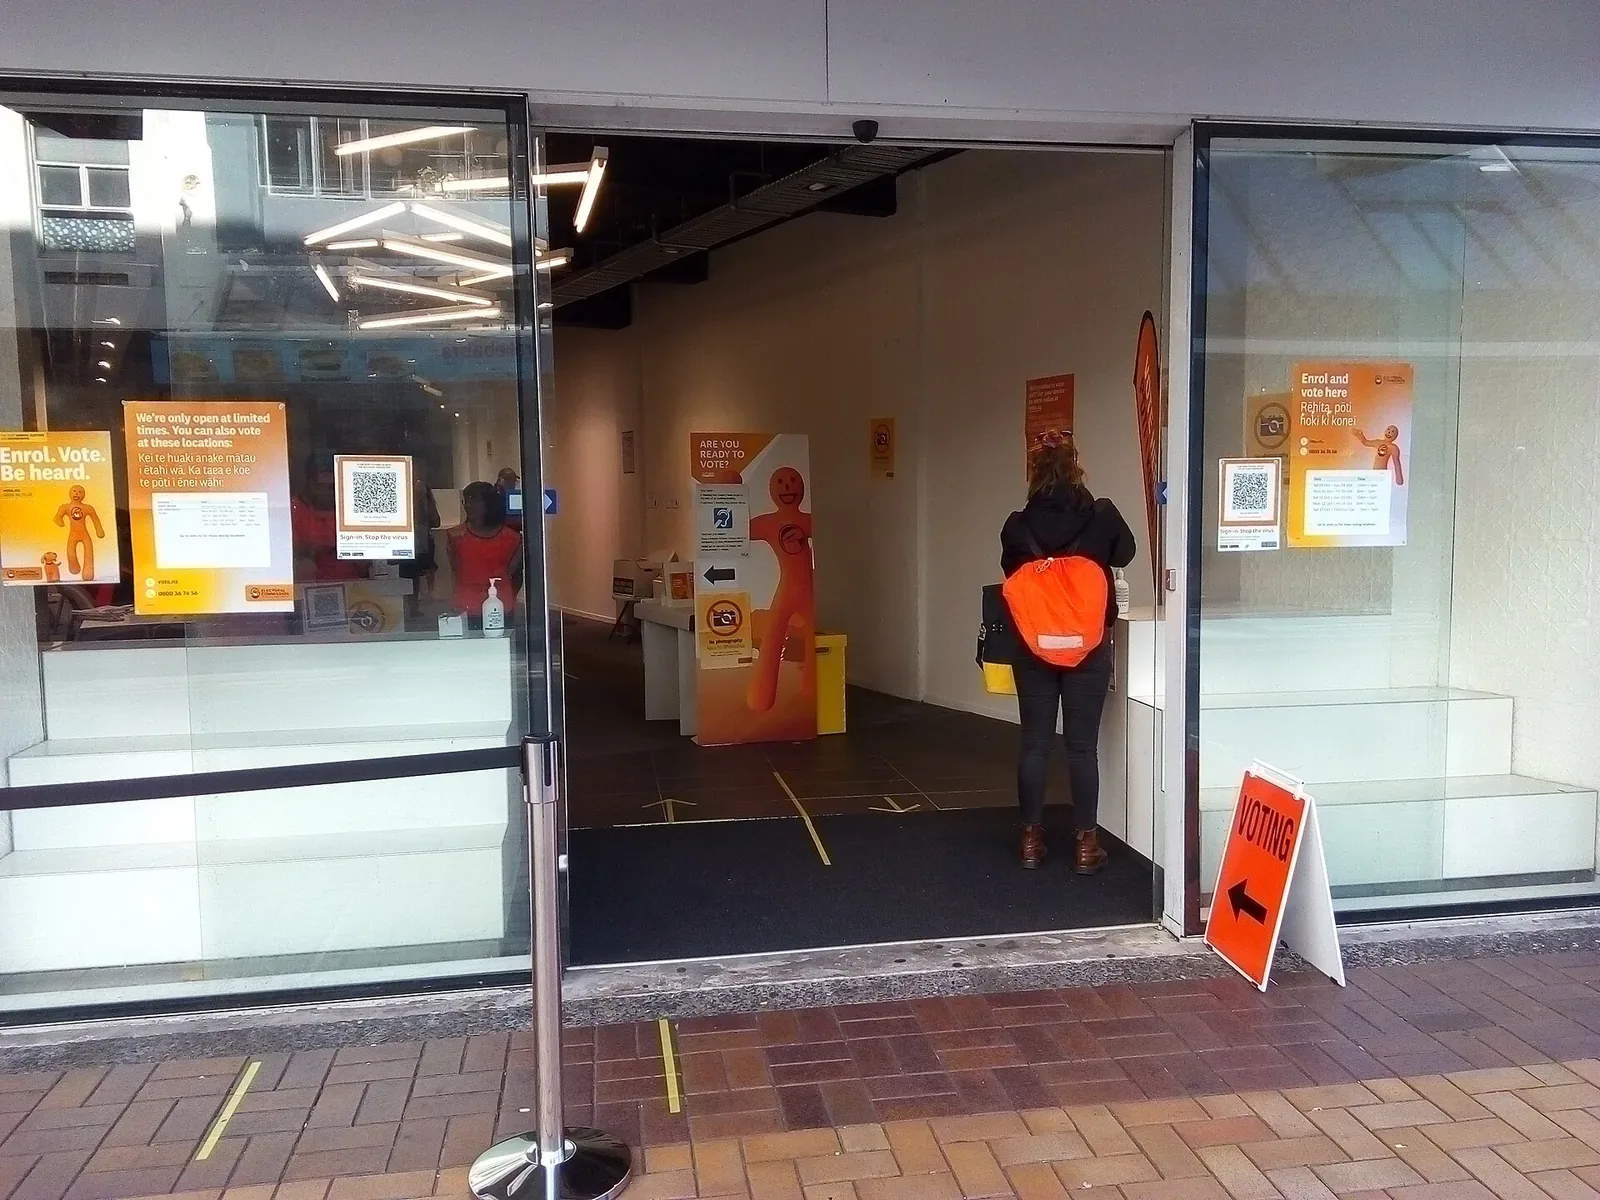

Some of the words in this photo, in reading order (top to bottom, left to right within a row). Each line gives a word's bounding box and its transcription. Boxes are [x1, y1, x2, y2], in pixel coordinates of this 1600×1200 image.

[1302, 372, 1328, 384] Enrol
[1330, 373, 1349, 384] and
[1301, 387, 1323, 398] vote
[1325, 386, 1348, 398] here
[1334, 401, 1352, 414] pōti
[136, 412, 167, 424] We're
[168, 413, 191, 426] only
[193, 414, 219, 426] open
[221, 414, 232, 424] at
[233, 412, 270, 424] limited
[1300, 413, 1319, 426] hoki
[1321, 413, 1329, 426] ki
[1331, 414, 1357, 427] konei
[136, 425, 170, 436] times.
[171, 426, 192, 436] You
[193, 427, 213, 436] can
[215, 425, 237, 436] also
[238, 426, 261, 436] vote
[137, 438, 149, 448] at
[150, 437, 180, 448] these
[182, 438, 233, 448] locations:
[700, 440, 718, 449] ARE
[719, 440, 740, 449] YOU
[0, 445, 57, 464] Enrol.
[57, 446, 106, 463] Vote.
[138, 453, 154, 463] Kei
[155, 454, 165, 463] te
[167, 453, 194, 463] huaki
[195, 453, 224, 463] anake
[225, 453, 256, 463] mātau
[700, 450, 731, 459] READY
[732, 450, 745, 459] TO
[144, 465, 168, 475] ētahi
[170, 465, 186, 475] wā.
[188, 465, 201, 475] Ka
[203, 466, 224, 475] taea
[225, 467, 231, 475] e
[233, 465, 251, 475] koe
[700, 460, 729, 469] VOTE?
[1, 464, 26, 481] Be
[29, 463, 91, 481] heard.
[140, 478, 150, 487] te
[152, 478, 171, 489] pōti
[178, 478, 198, 487] ēnei
[1238, 794, 1294, 863] VOTING
